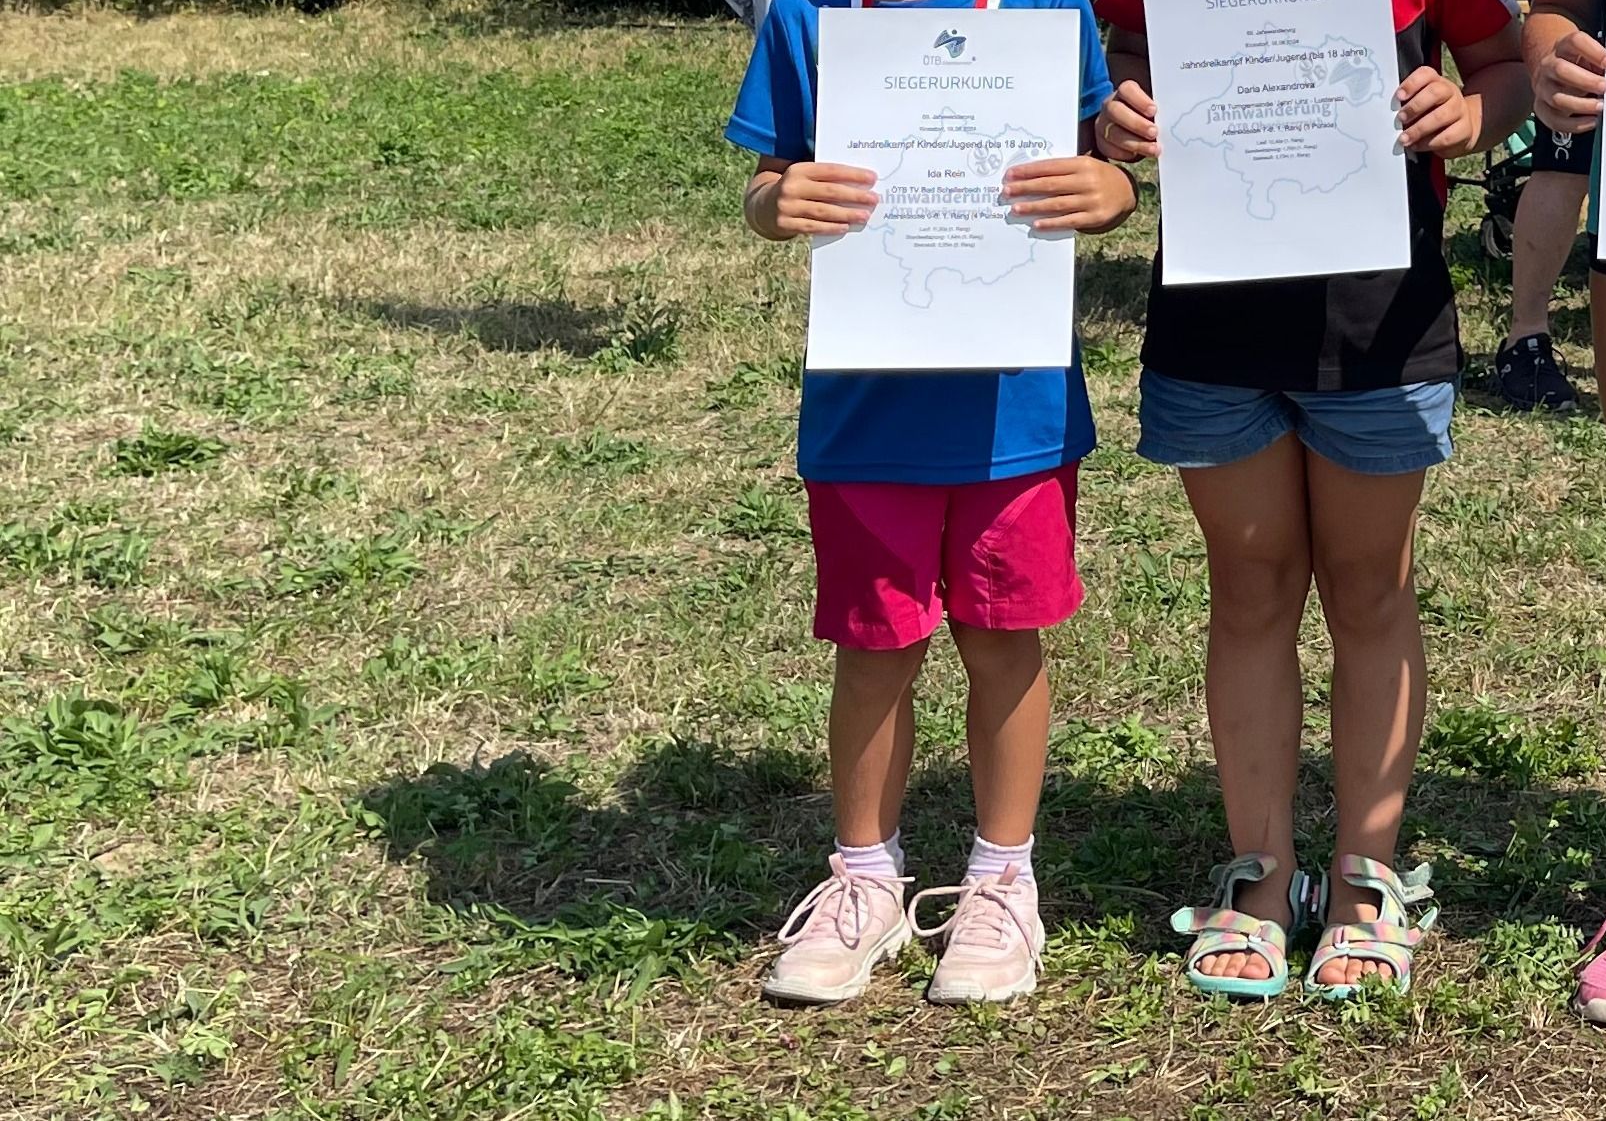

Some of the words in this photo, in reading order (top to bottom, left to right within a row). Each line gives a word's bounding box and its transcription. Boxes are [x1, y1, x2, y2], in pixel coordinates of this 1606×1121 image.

[923, 55, 942, 66] ÖTB
[1180, 58, 1244, 70] Jahndreikampf
[1245, 53, 1307, 67] Kinder/Jugend
[1309, 51, 1325, 63] (bis
[1327, 50, 1338, 59] 18
[1340, 47, 1368, 58] Jahre)
[884, 76, 1015, 90] SIEGERURKUNDE
[1237, 85, 1261, 95] Daria
[1206, 102, 1332, 125] Jahnwanderung
[847, 140, 914, 151] Jahndreikampf
[917, 140, 983, 151] Kinder/Jugend
[984, 140, 1002, 151] (bis
[1004, 140, 1016, 149] 18
[1018, 140, 1048, 151] Jahre)
[928, 170, 942, 179] Ida
[945, 170, 966, 179] Rein
[891, 185, 908, 194] ÖTB
[879, 189, 1000, 206] hnwanderung
